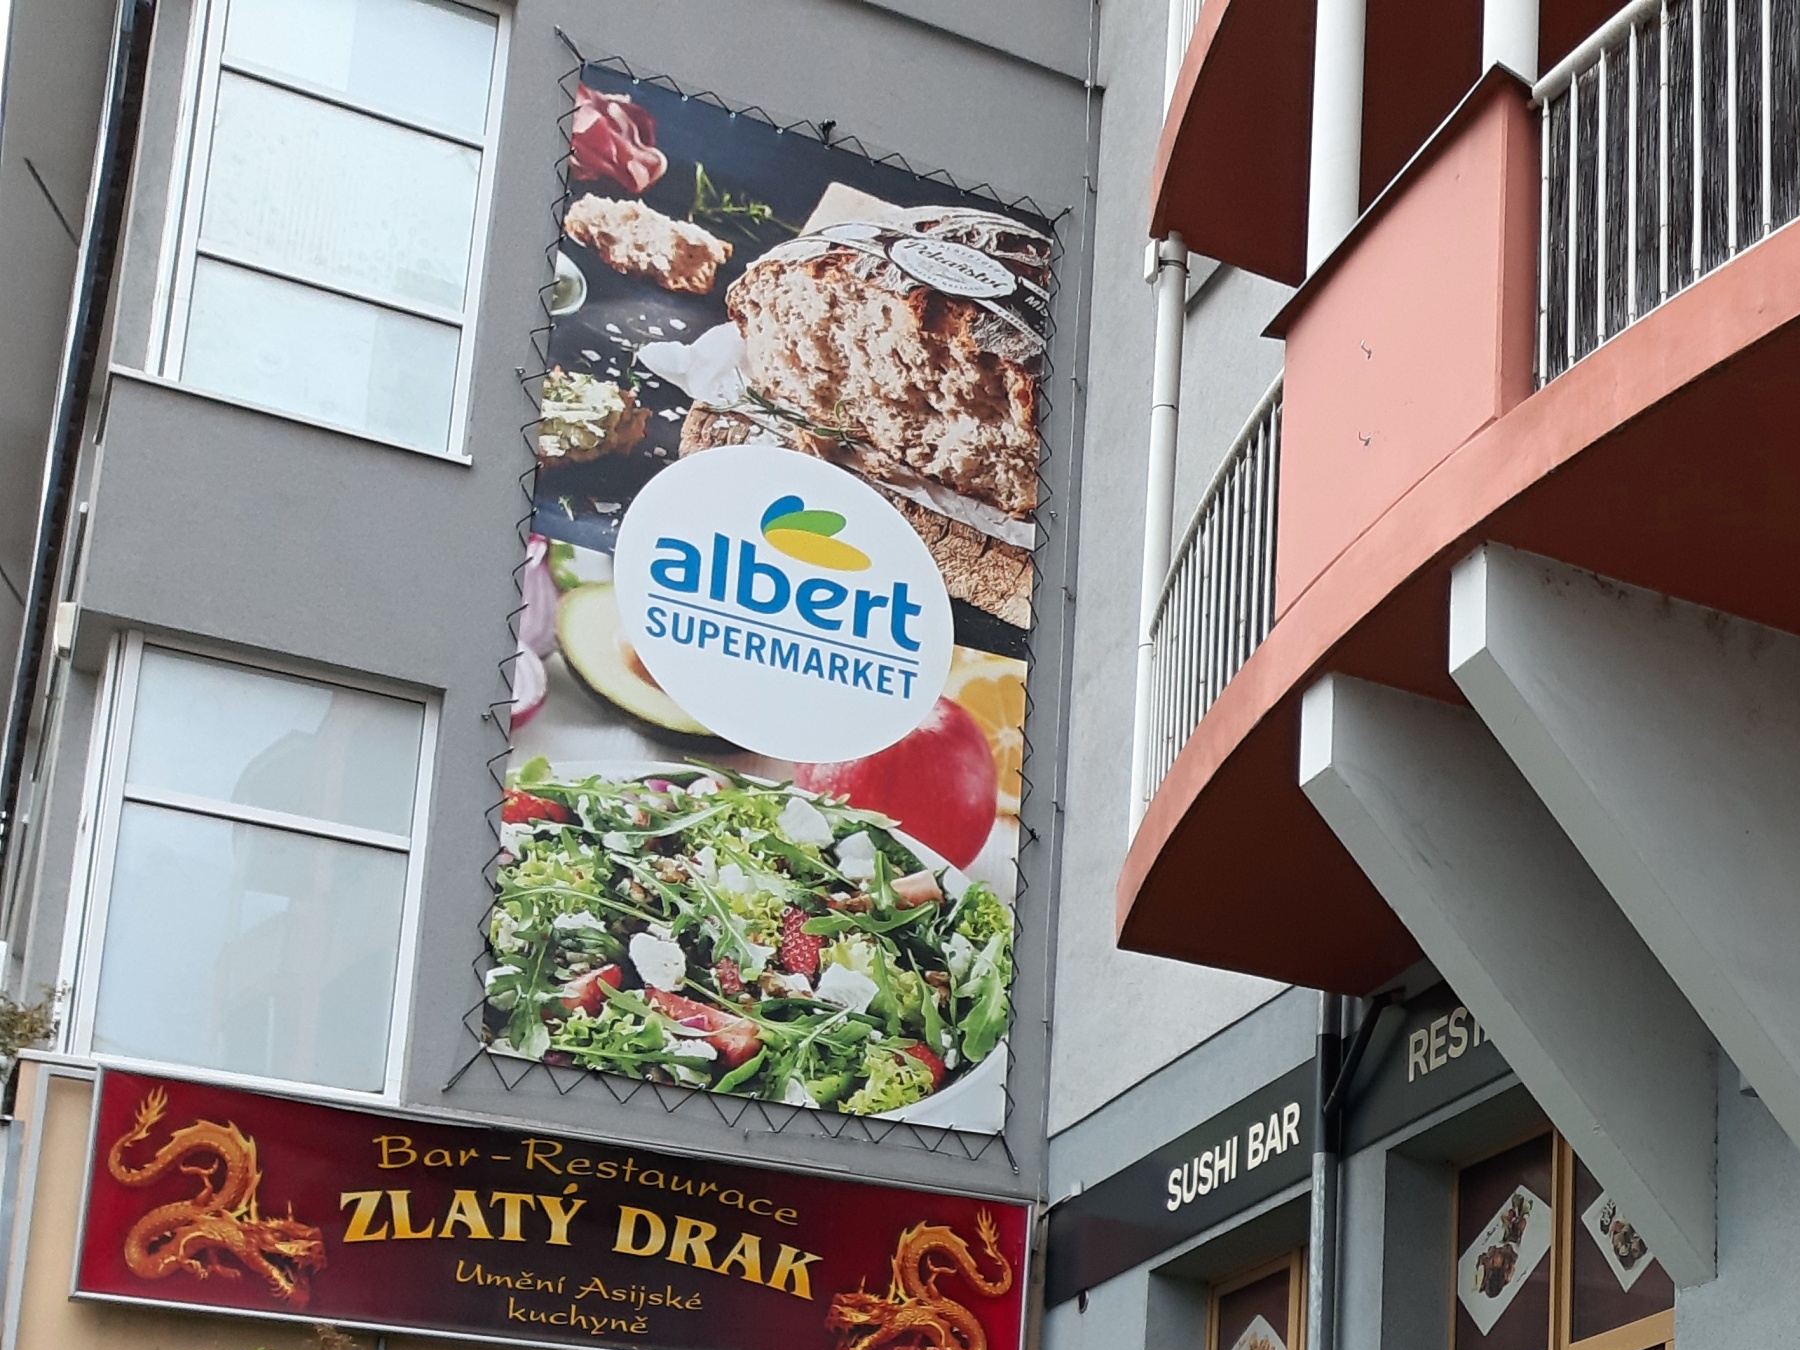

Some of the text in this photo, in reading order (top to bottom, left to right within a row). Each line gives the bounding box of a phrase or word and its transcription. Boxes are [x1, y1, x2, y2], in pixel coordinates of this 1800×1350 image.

[649, 531, 923, 652] albert
[645, 605, 918, 700] SUPERMARKET
[1166, 1101, 1301, 1213] SUSHI BAR
[340, 1183, 824, 1300] ZLATÝ DRAK
[456, 1258, 703, 1312] Umění Asijské
[508, 1298, 649, 1335] kuchyně
